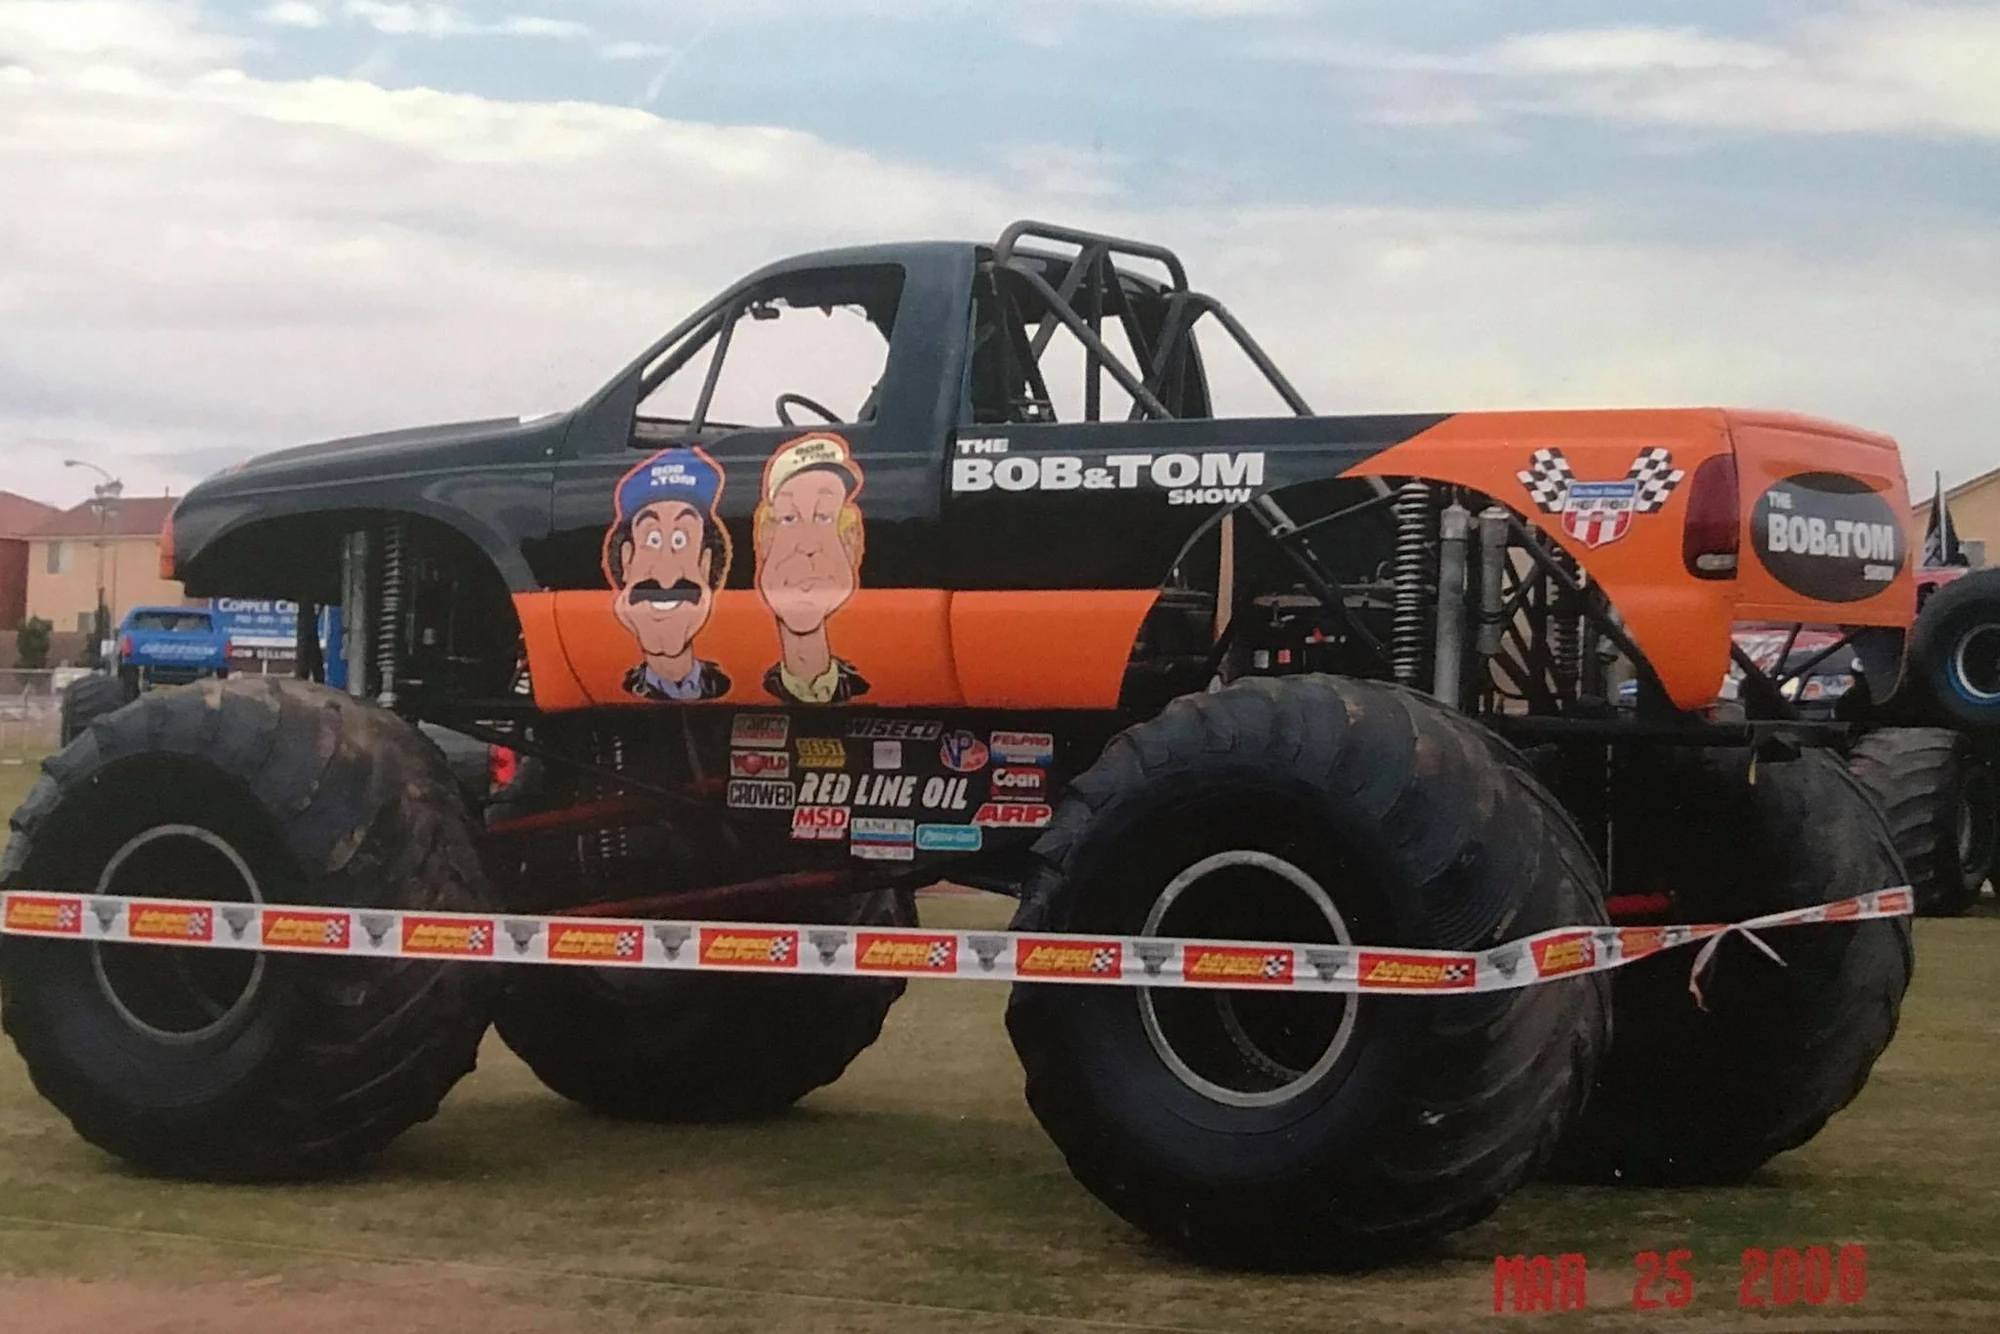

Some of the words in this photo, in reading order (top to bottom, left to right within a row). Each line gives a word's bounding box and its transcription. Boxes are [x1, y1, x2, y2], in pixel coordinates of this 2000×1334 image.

[956, 438, 1009, 454] THE
[952, 452, 1265, 491] BOB&TOM
[1168, 487, 1252, 505] SHOW
[1767, 490, 1793, 509] THE
[1767, 512, 1895, 561] BOB&TOM
[992, 768, 1040, 788] Coan
[731, 783, 795, 805] CROWER
[797, 773, 851, 804] RED
[854, 775, 917, 807] LINE
[921, 777, 968, 809] OIL
[795, 807, 846, 827] MSD
[975, 804, 1051, 824] ARP
